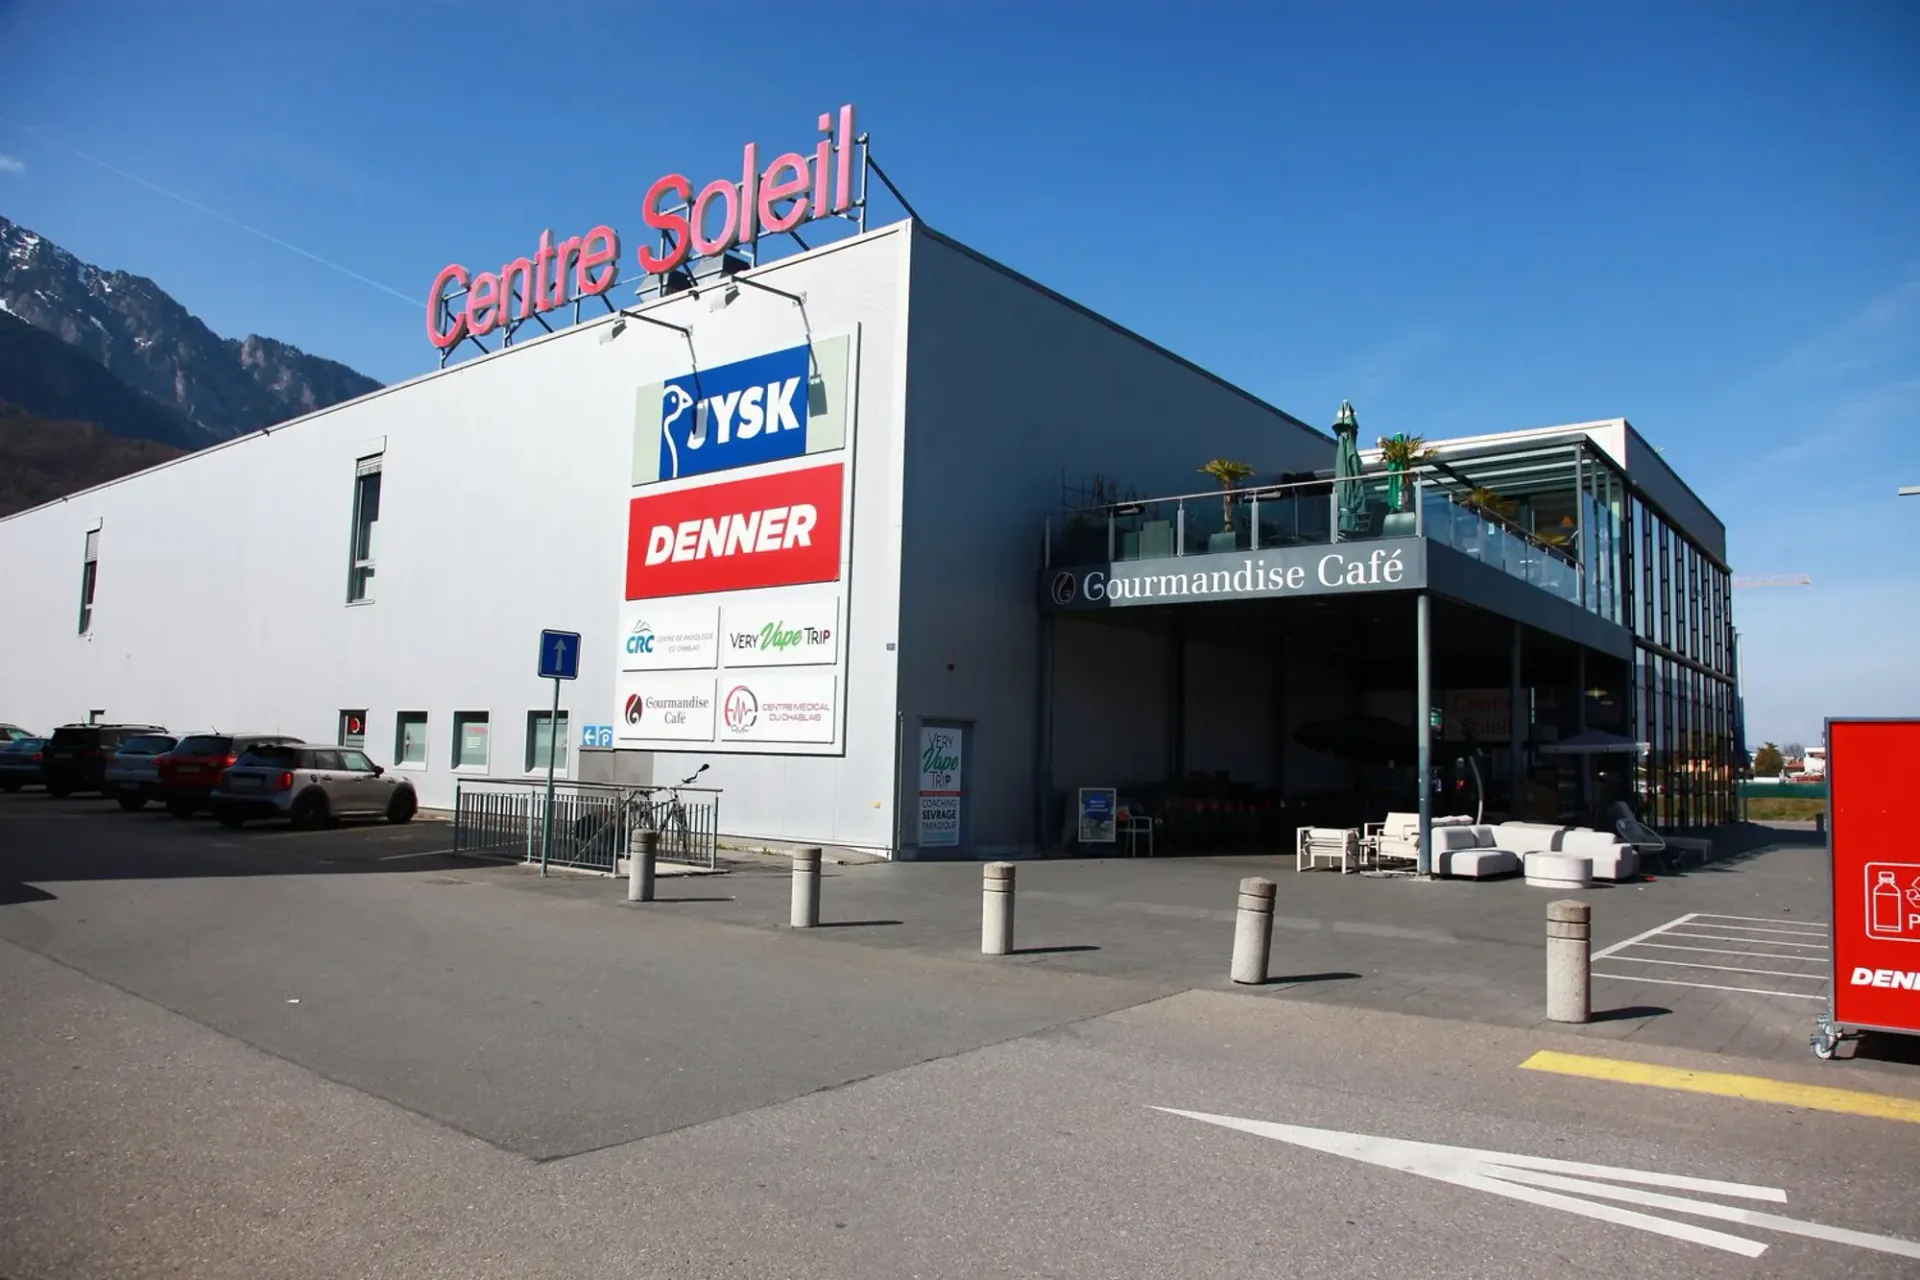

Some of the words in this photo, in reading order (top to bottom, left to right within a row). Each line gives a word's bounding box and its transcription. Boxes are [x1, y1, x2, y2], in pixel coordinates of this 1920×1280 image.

[426, 225, 621, 348] Centre
[637, 103, 857, 274] Soleil
[686, 376, 801, 450] JYSK
[644, 503, 818, 566] DENNER
[1083, 559, 1305, 601] Gourmandise
[1317, 548, 1405, 587] Café
[626, 634, 655, 654] CRC
[760, 620, 803, 652] Vape
[645, 695, 709, 709] Gourmandise
[762, 703, 793, 711] CENTRE
[664, 711, 686, 724] Café
[769, 713, 781, 721] DU
[781, 713, 822, 721] CHABLAIS
[603, 735, 610, 746] P
[922, 746, 959, 774] Vape
[921, 799, 957, 808] COACHING
[922, 809, 957, 820] SEVRAGE
